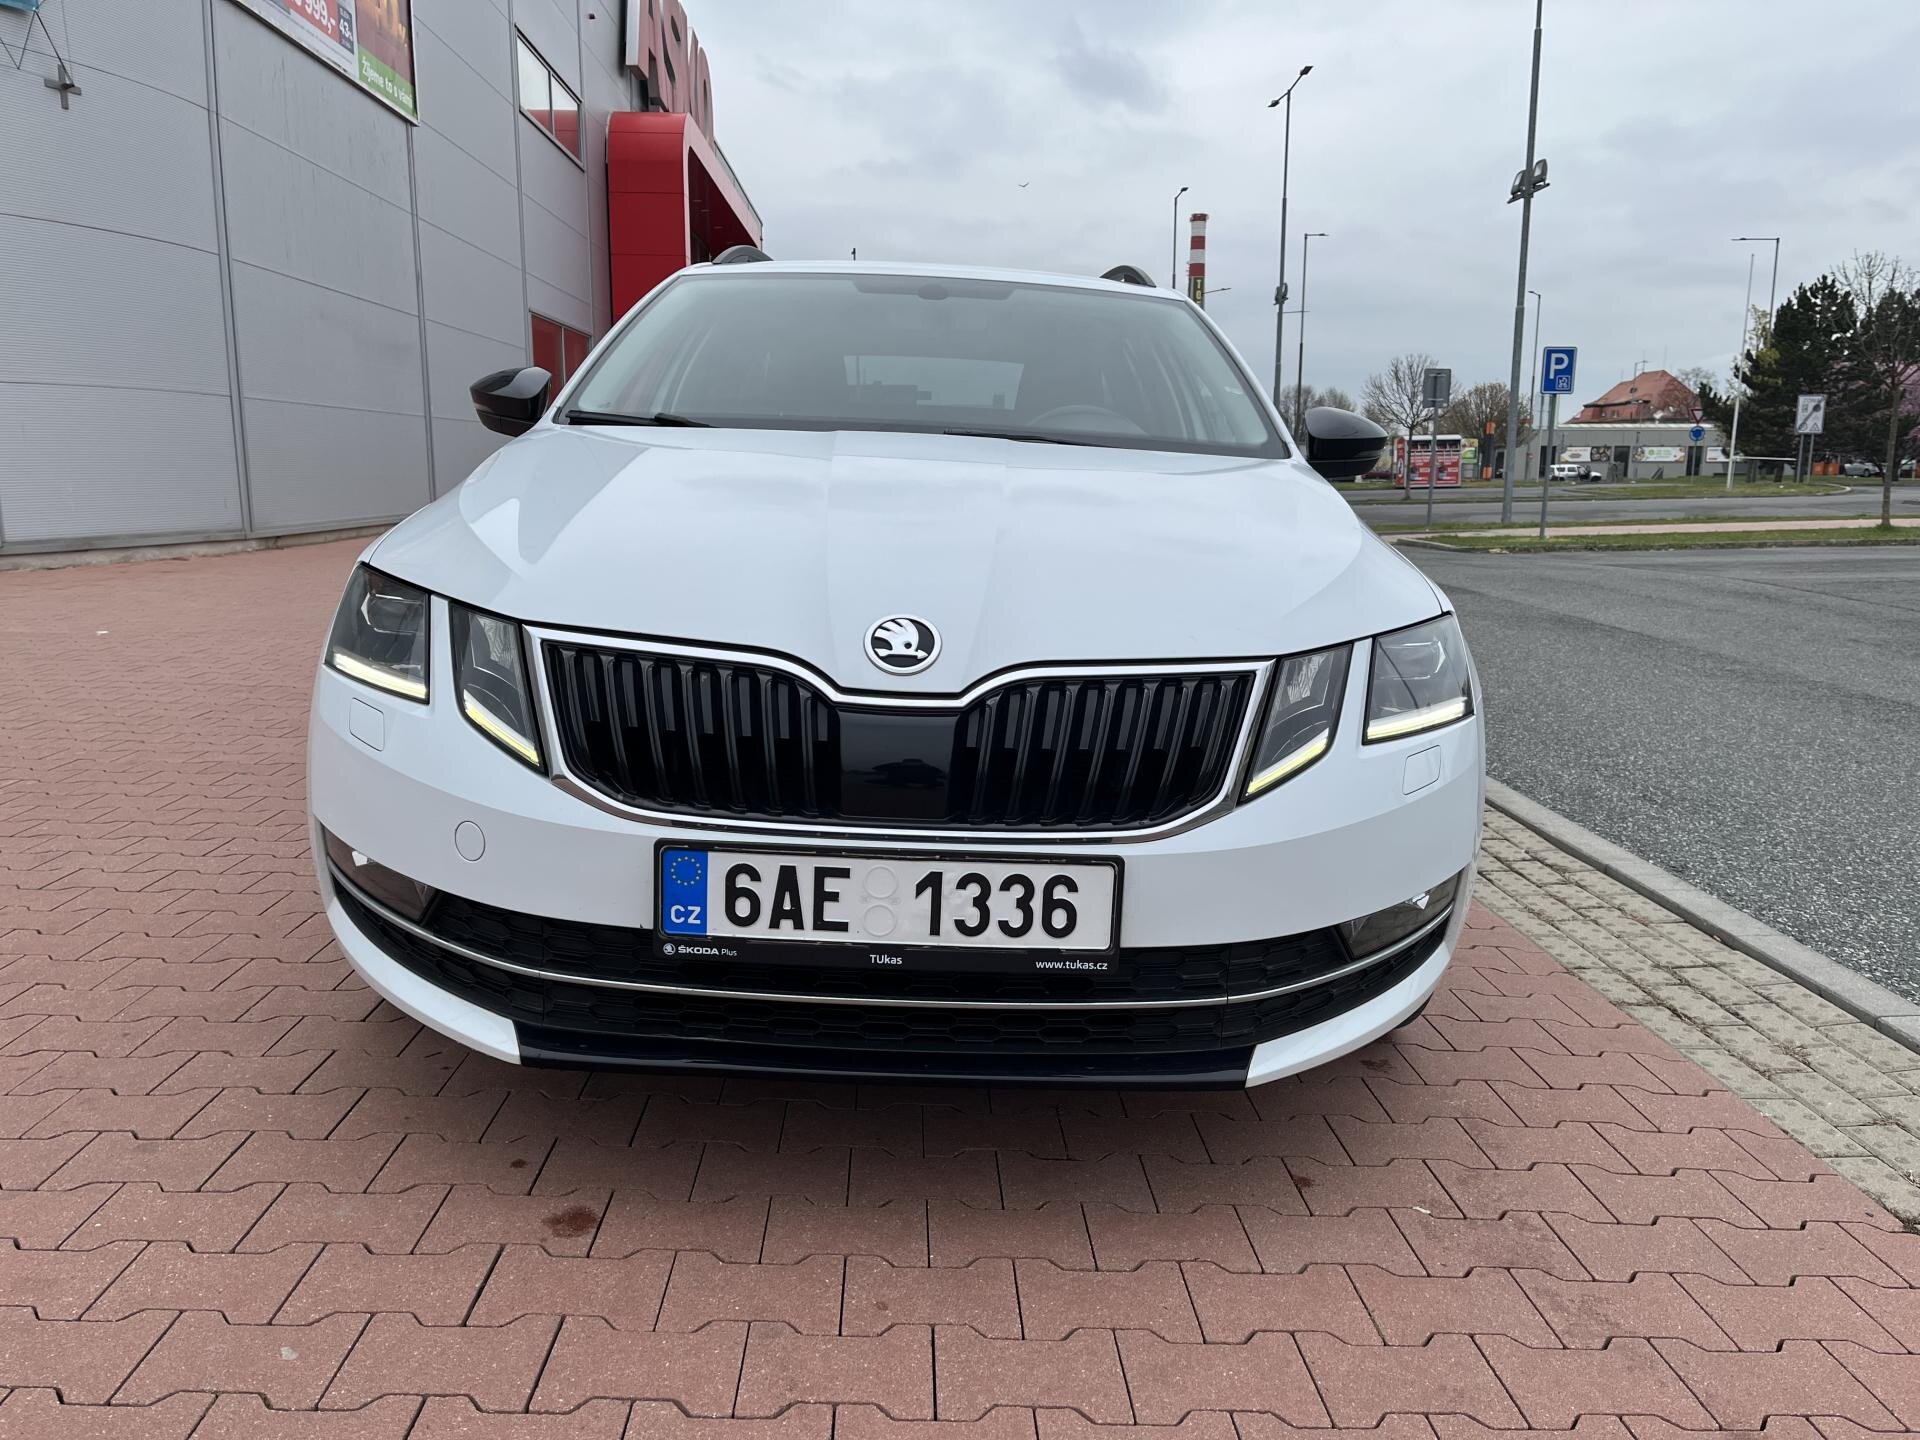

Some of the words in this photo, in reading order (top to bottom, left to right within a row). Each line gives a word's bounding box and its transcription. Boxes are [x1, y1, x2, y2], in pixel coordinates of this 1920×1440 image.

[1549, 353, 1569, 379] P
[724, 863, 851, 932] 6AE
[914, 871, 1079, 938] 1336
[669, 904, 702, 925] CZ
[678, 945, 719, 956] ŠKODA
[721, 948, 738, 957] Plus
[1035, 959, 1108, 970] www.tukas.cz
